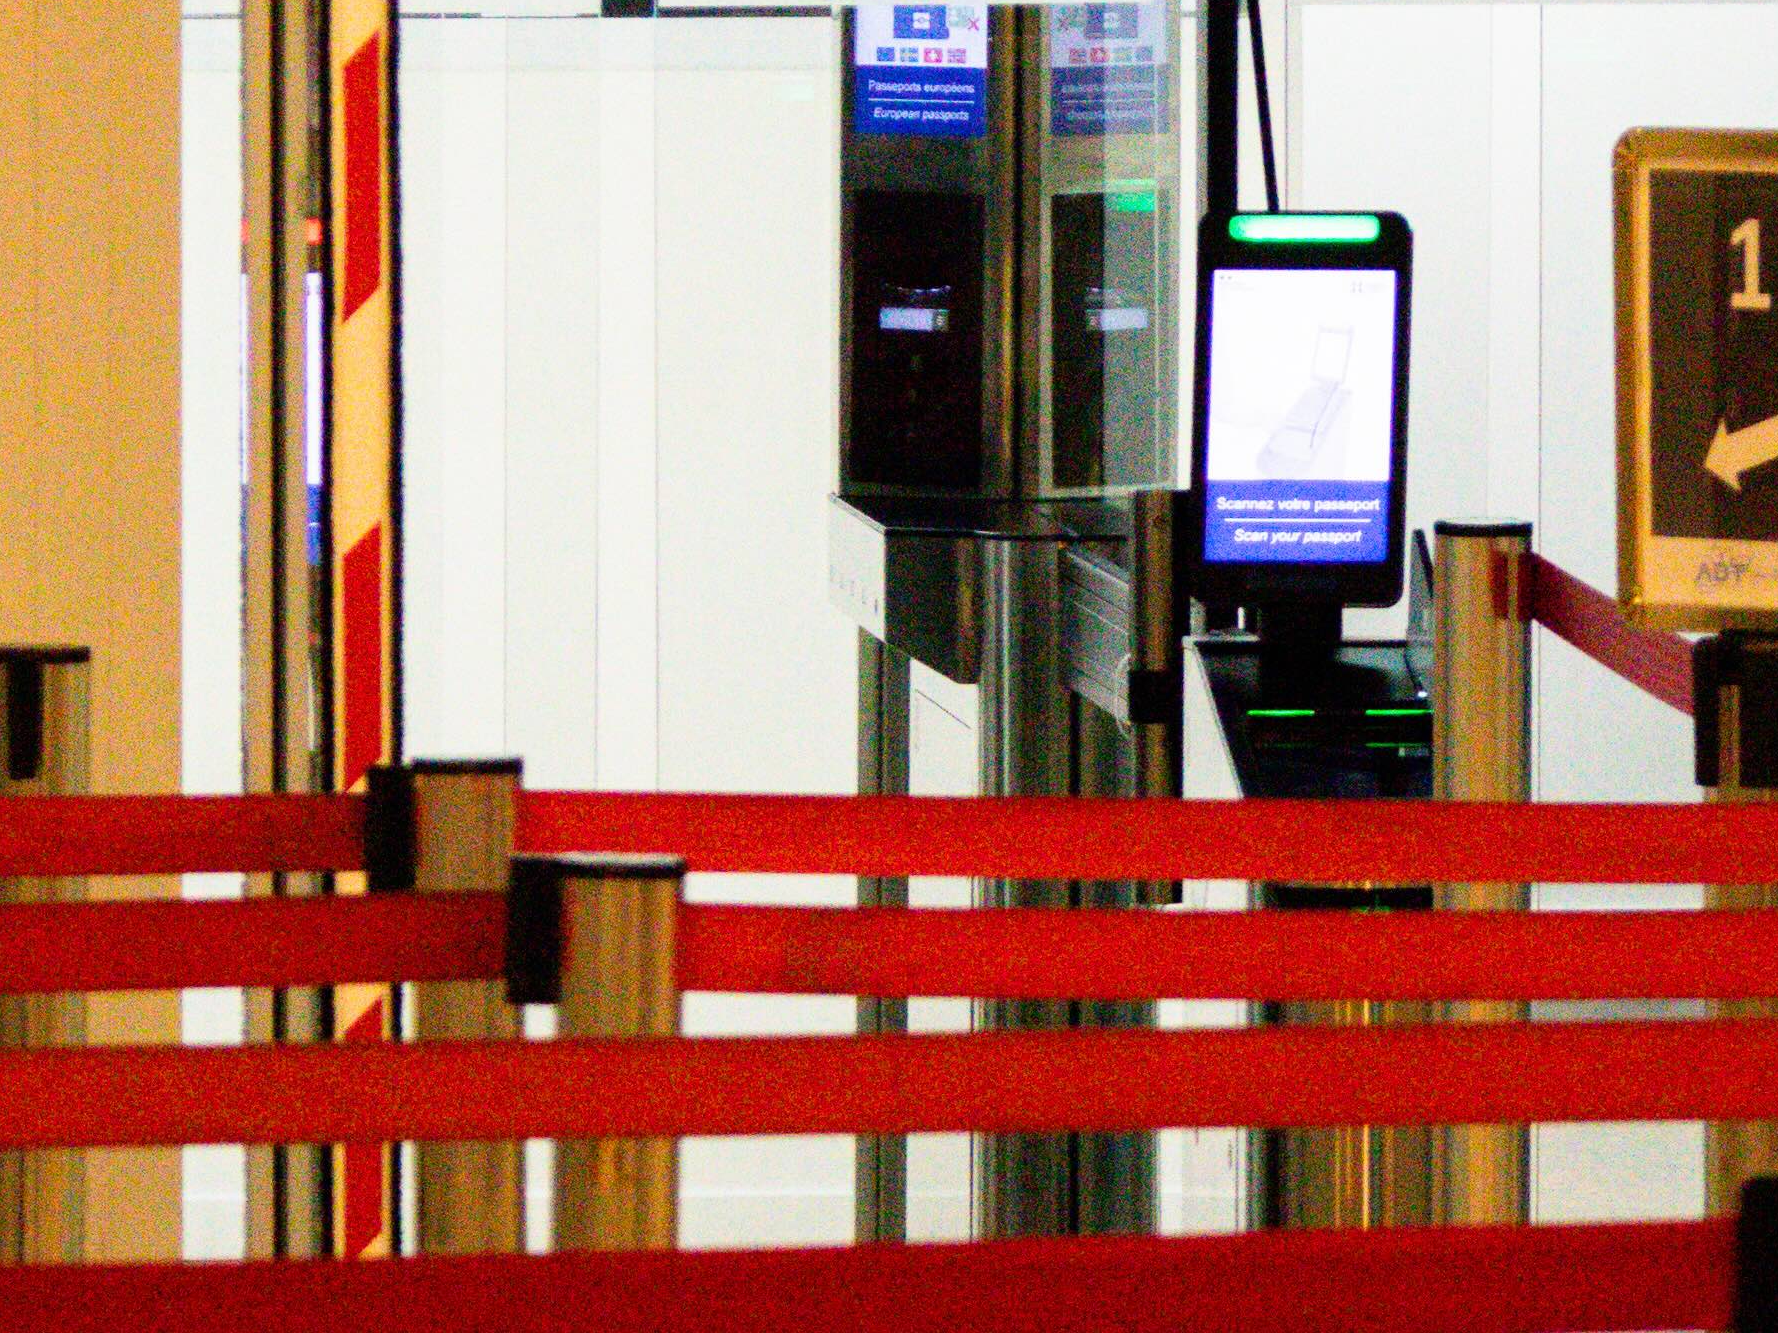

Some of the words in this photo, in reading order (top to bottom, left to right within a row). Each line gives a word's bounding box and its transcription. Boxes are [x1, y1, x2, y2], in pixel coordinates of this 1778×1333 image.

[1730, 218, 1772, 310] 1
[1216, 496, 1274, 511] Scannez
[1277, 498, 1311, 511] votre
[1313, 498, 1381, 513] passeport
[1233, 527, 1269, 542] Scan
[1269, 531, 1302, 545] your
[1302, 530, 1363, 545] passport
